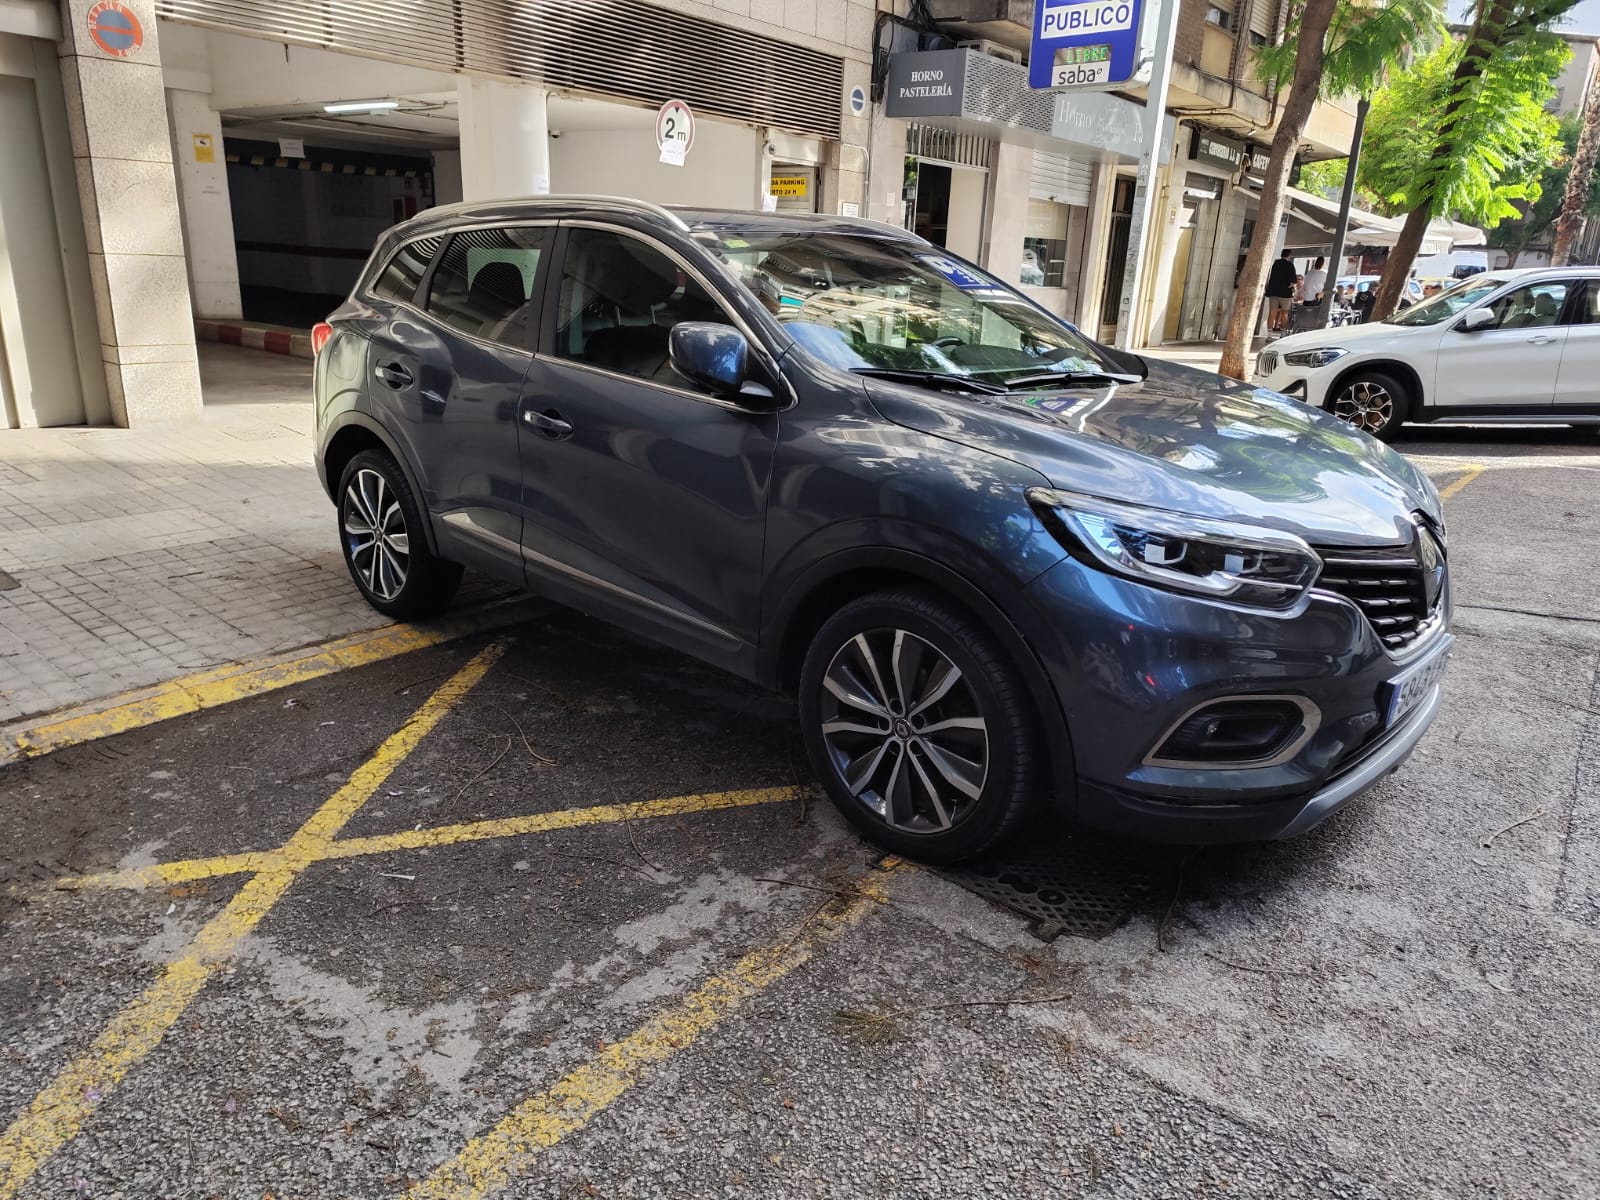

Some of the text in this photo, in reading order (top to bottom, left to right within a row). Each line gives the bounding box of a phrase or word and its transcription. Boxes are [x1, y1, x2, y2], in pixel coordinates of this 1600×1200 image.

[1043, 4, 1130, 33] PUBLICO
[1065, 46, 1109, 65] LIBRE
[911, 69, 944, 82] HORNO
[899, 82, 953, 98] PASTELERÍA
[1059, 99, 1093, 130] Horno
[664, 117, 687, 142] 2 m
